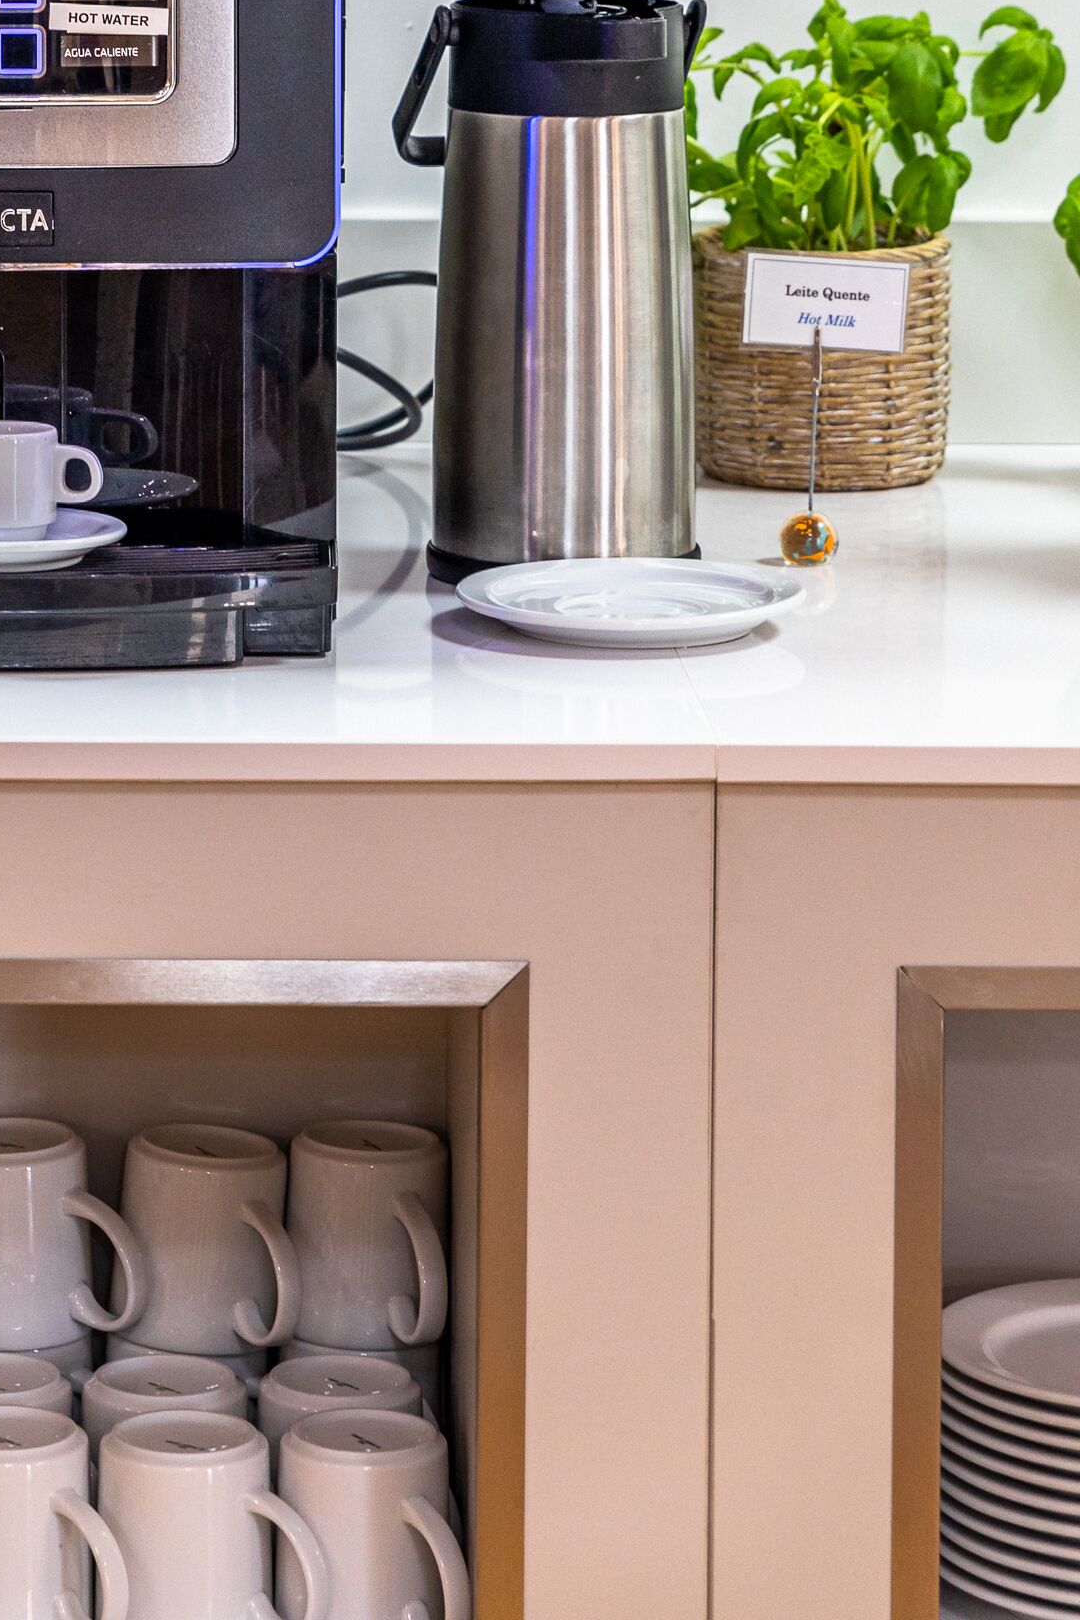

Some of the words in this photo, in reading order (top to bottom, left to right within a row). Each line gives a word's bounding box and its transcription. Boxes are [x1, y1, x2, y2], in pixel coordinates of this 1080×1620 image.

[68, 12, 98, 24] HOT
[102, 13, 149, 27] WATER
[64, 47, 92, 58] AGUA
[94, 47, 139, 58] CALIENTE
[785, 284, 819, 298] Leite
[822, 287, 871, 301] Quente
[797, 312, 822, 325] Hot
[825, 314, 857, 327] Milk
